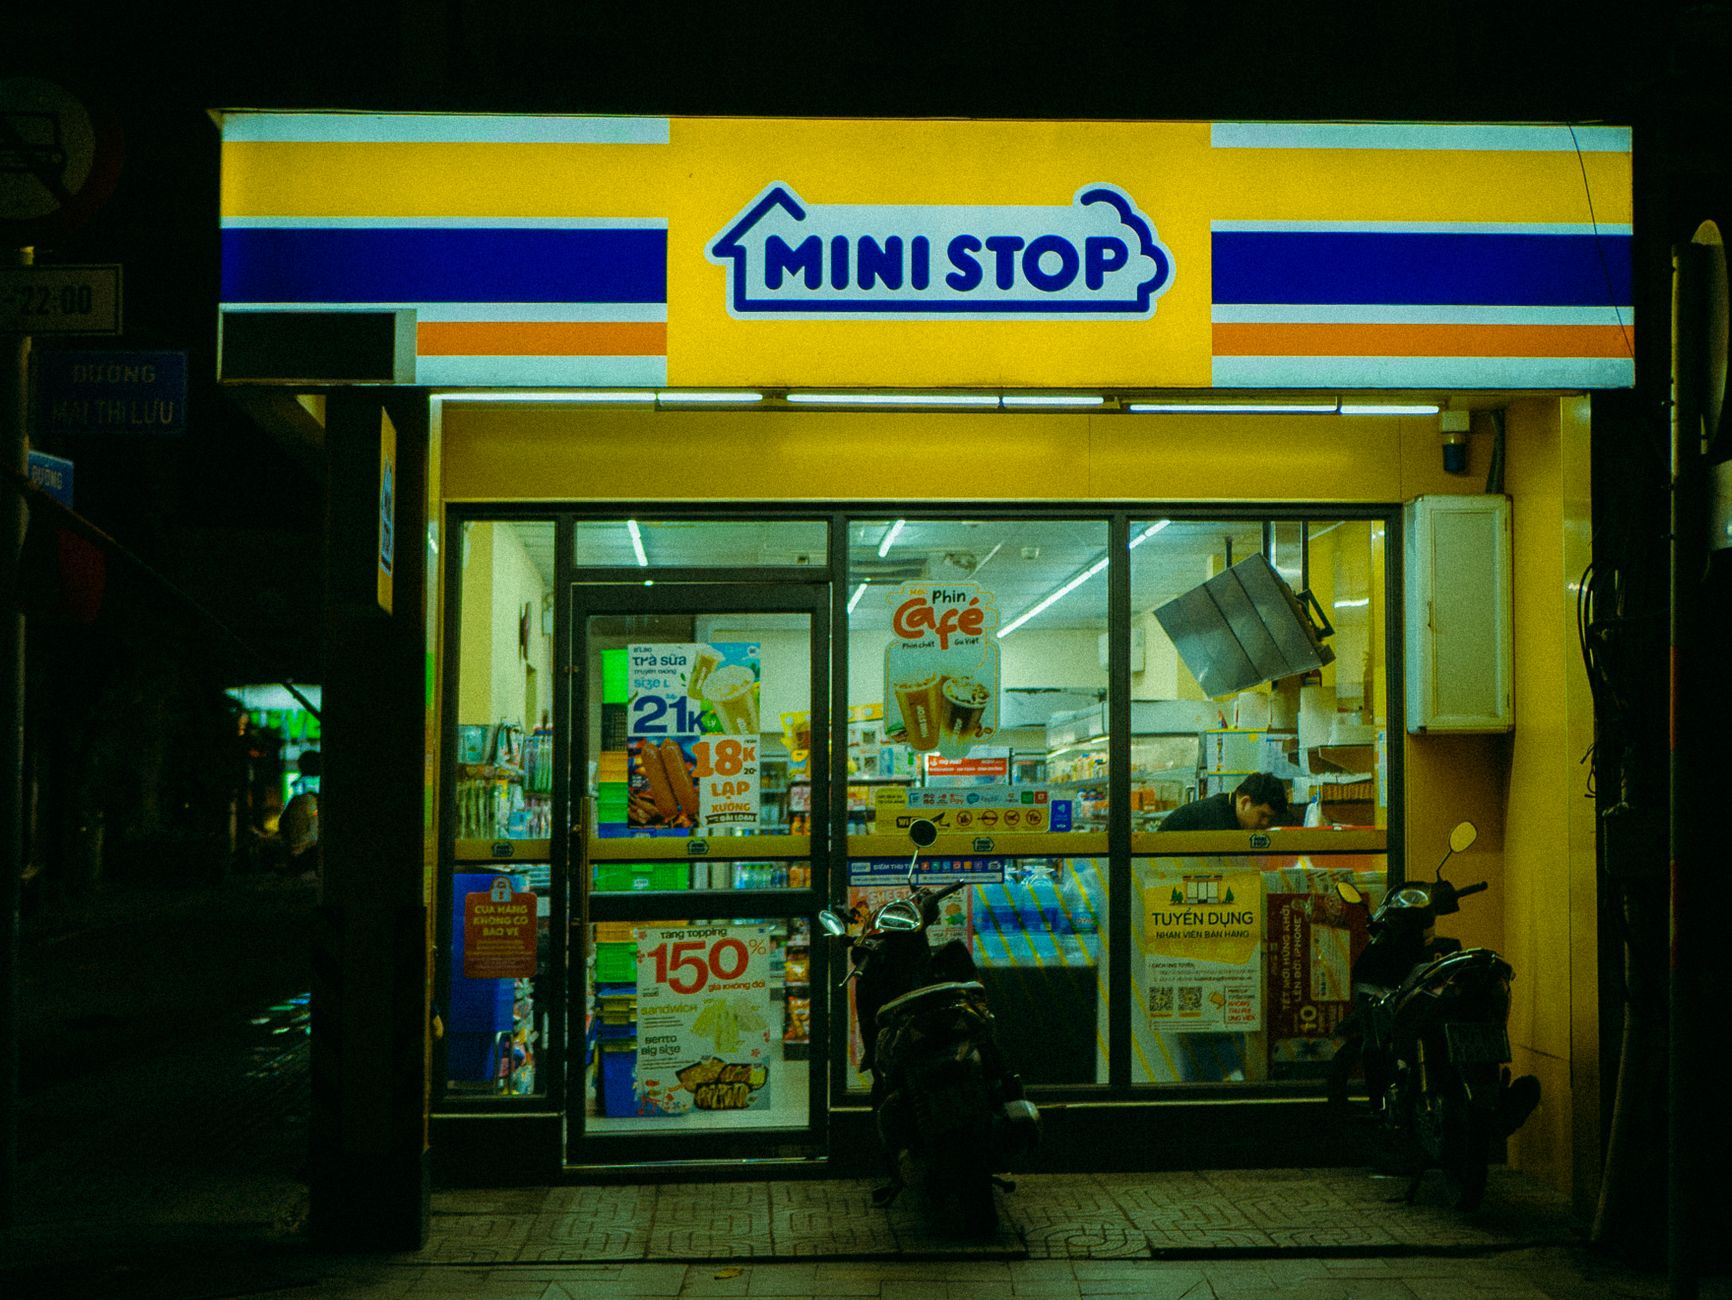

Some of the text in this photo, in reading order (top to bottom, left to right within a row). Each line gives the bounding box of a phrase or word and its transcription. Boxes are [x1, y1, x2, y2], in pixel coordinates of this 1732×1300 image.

[764, 234, 1129, 292] MINI STOP
[932, 590, 966, 604] Phin
[893, 597, 984, 651] Café
[711, 781, 750, 800] LẠP
[1208, 911, 1254, 928] DỤNG
